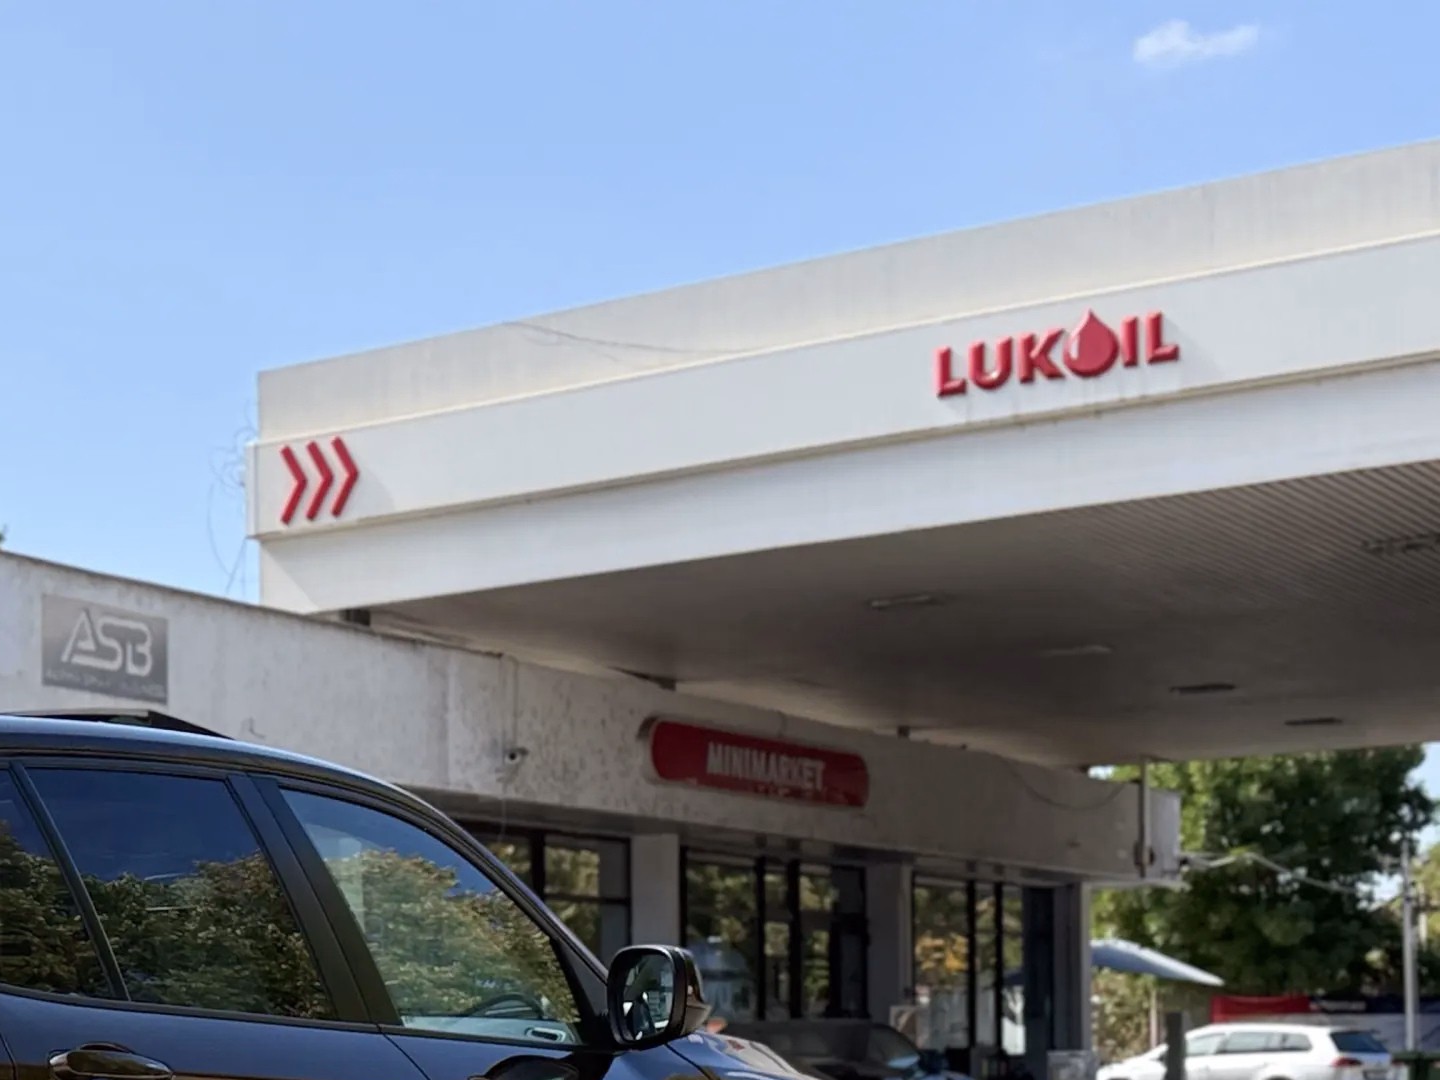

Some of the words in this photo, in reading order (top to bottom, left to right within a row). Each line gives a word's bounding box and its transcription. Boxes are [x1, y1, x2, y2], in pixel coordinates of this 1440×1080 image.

[934, 309, 1179, 397] LUKOIL
[61, 609, 152, 677] ASB
[707, 741, 826, 791] MINIMARKET
